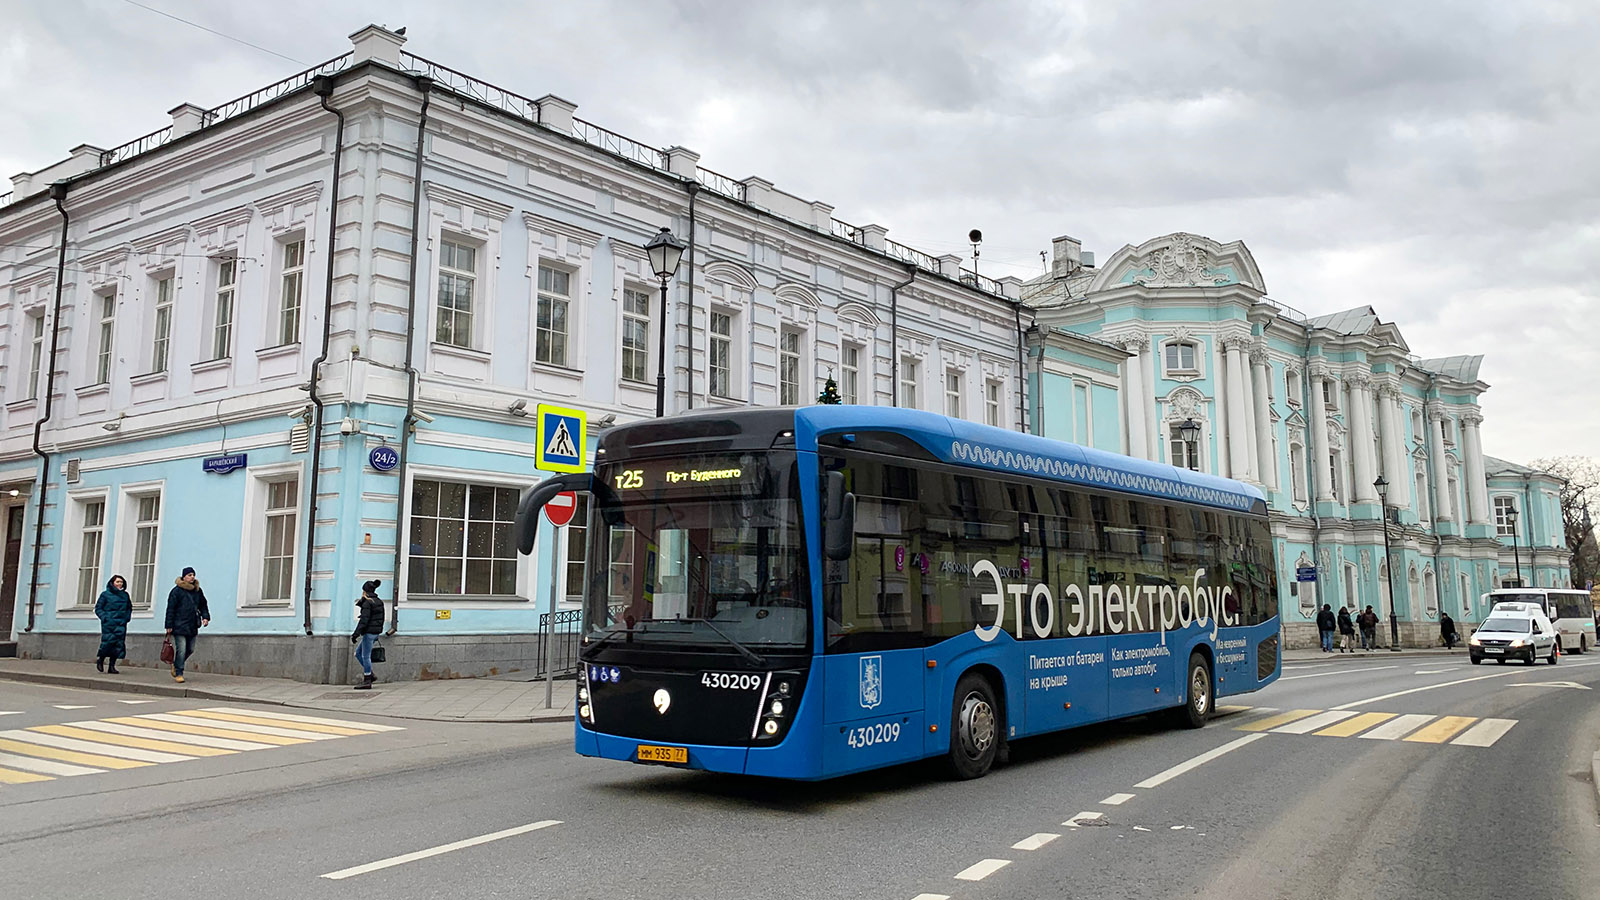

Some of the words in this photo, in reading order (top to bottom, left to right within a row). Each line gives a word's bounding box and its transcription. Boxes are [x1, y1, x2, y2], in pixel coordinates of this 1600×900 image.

[374, 452, 396, 464] 24/2
[615, 470, 644, 489] т25
[666, 471, 689, 483] Пр-т
[690, 468, 741, 481] Буденного
[972, 559, 1054, 642] Это
[1065, 568, 1240, 645] электробус.
[1029, 654, 1066, 670] Питается
[1066, 655, 1075, 667] от
[1075, 650, 1104, 667] батареи
[1111, 647, 1124, 661] Как
[1124, 644, 1170, 661] электромобиль,
[1112, 665, 1134, 679] только
[1134, 661, 1157, 677] автобус
[701, 672, 760, 690] 430209
[1029, 677, 1040, 690] на
[1041, 674, 1068, 691] крыше
[848, 722, 900, 749] 430209
[655, 748, 671, 759] 935
[675, 748, 684, 758] 77
